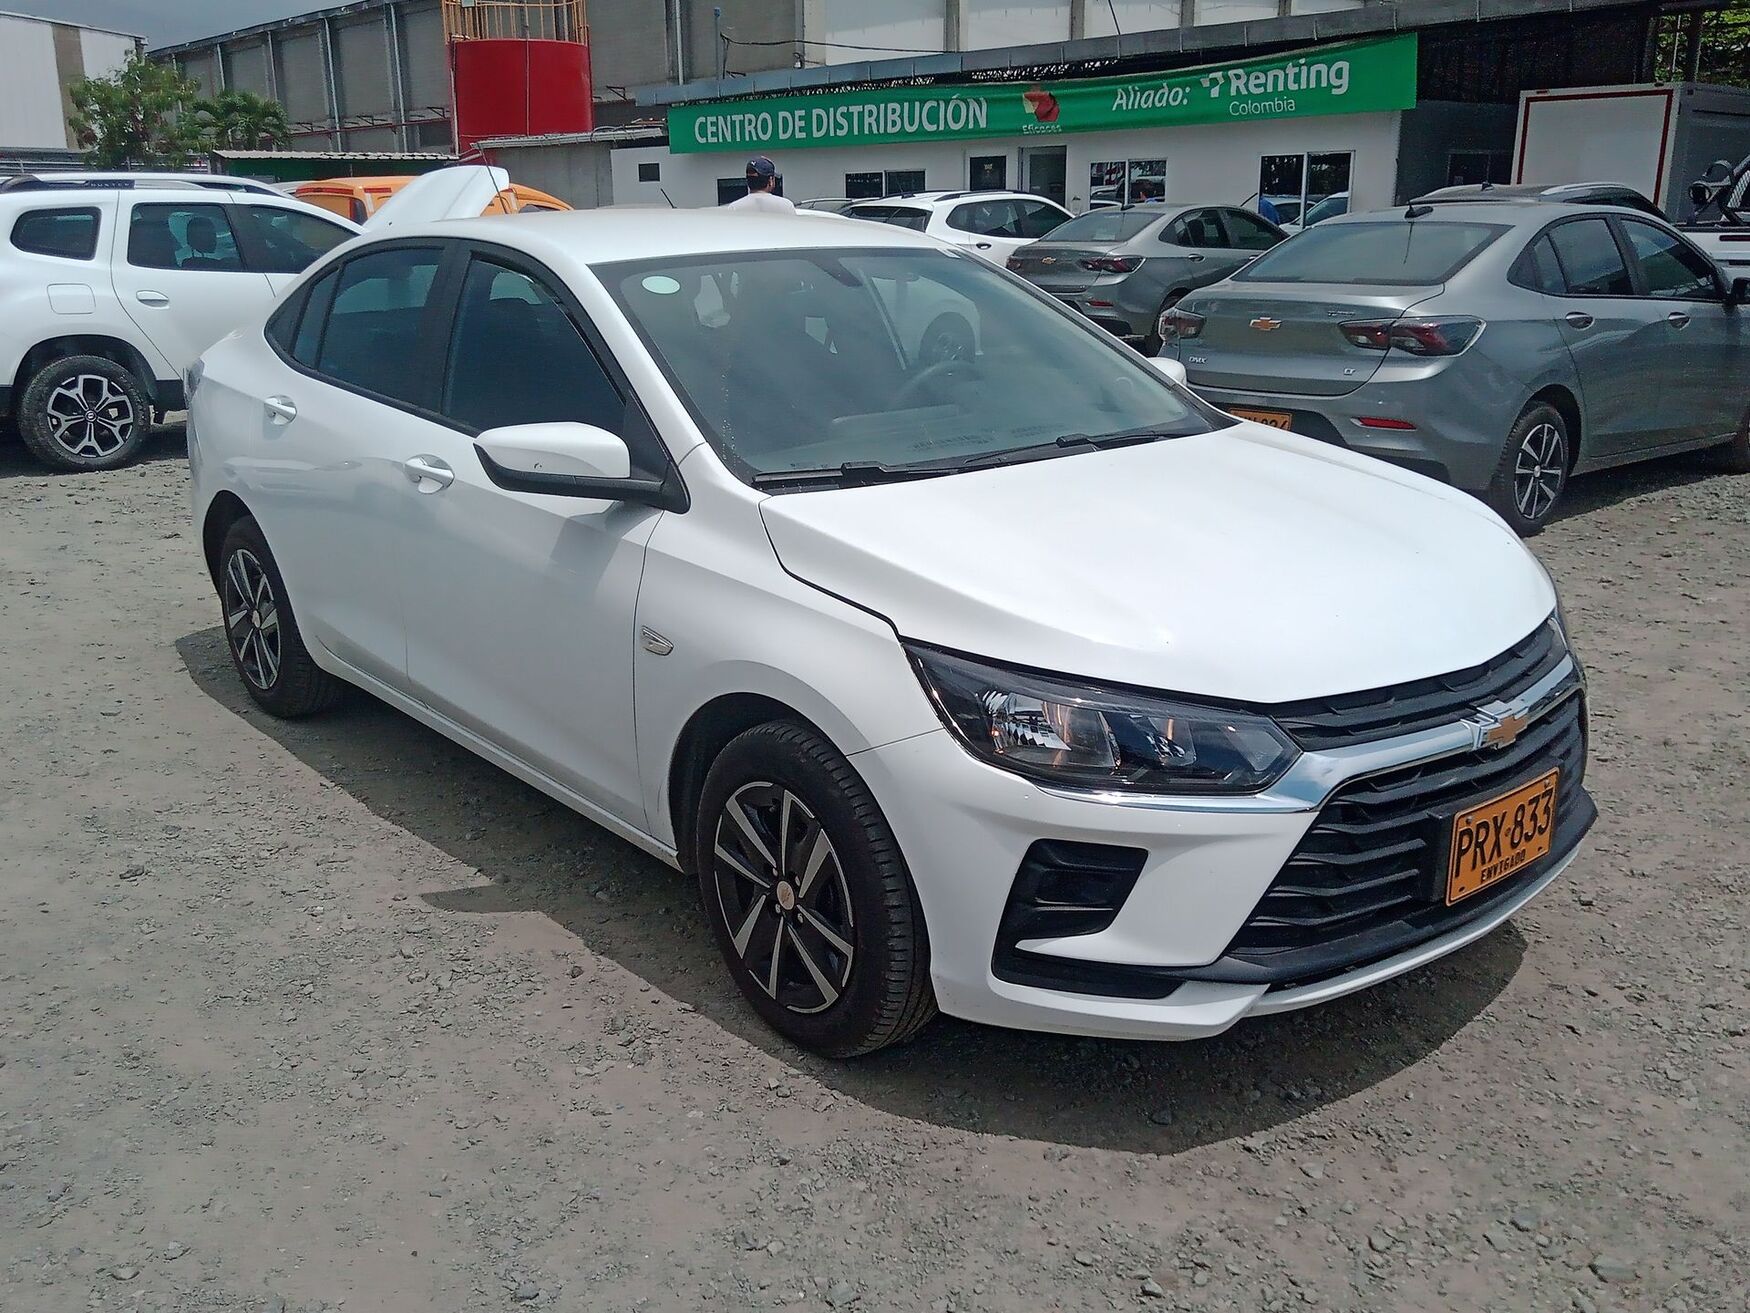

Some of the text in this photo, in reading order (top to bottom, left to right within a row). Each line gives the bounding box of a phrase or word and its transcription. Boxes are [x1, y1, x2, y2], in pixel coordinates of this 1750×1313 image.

[1111, 58, 1350, 111] Aliado: Renting
[1229, 96, 1296, 116] Colombia
[694, 93, 988, 144] CENTRO DE DISTRIBUCIÓN
[1480, 848, 1527, 884] ENVIGADO
